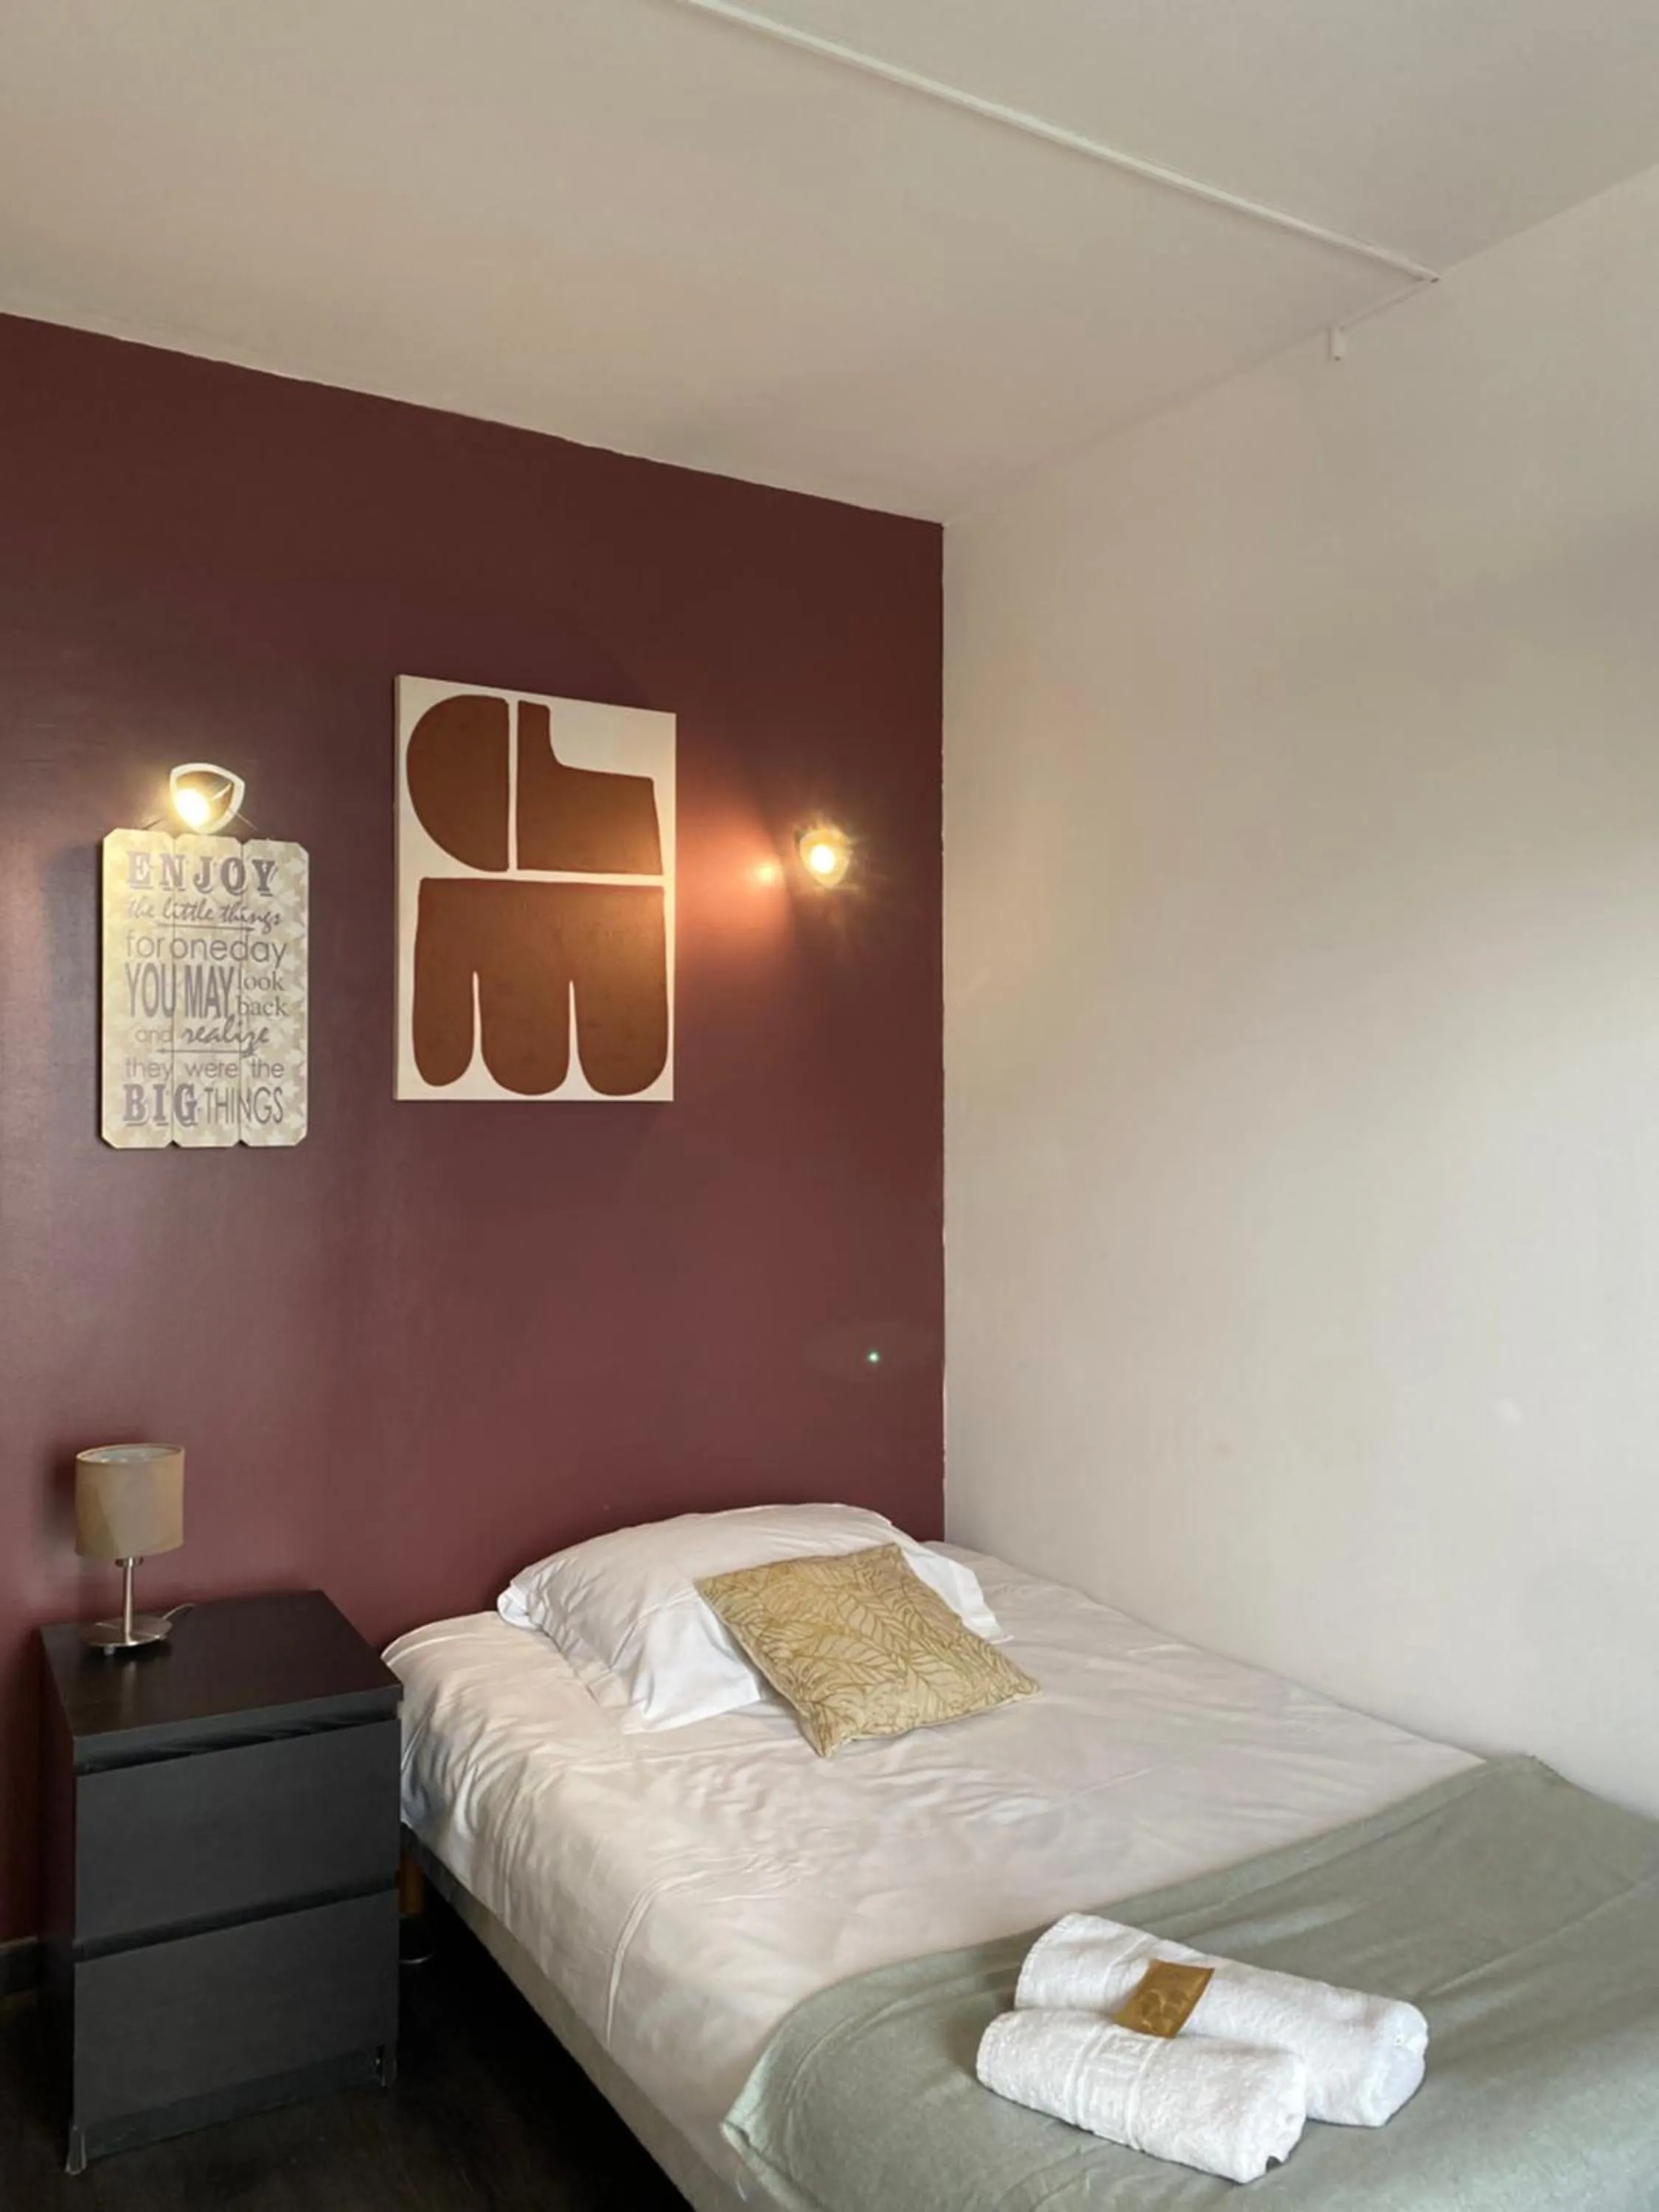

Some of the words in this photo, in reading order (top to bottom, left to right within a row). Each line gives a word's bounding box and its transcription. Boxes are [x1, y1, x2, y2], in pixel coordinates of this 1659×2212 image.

[126, 851, 278, 897] ENJOY
[161, 896, 215, 922] little
[221, 906, 282, 934] things
[125, 929, 165, 958] for
[125, 963, 176, 1018] YOU
[184, 964, 234, 1019] MAY
[237, 966, 285, 992] look
[237, 997, 289, 1017] back
[134, 1020, 174, 1043] and
[181, 1014, 271, 1058] realize
[125, 1057, 173, 1080] they
[184, 1063, 239, 1079] were
[251, 1059, 285, 1079] the
[122, 1083, 198, 1127] BIG
[204, 1087, 284, 1125] THINGS
